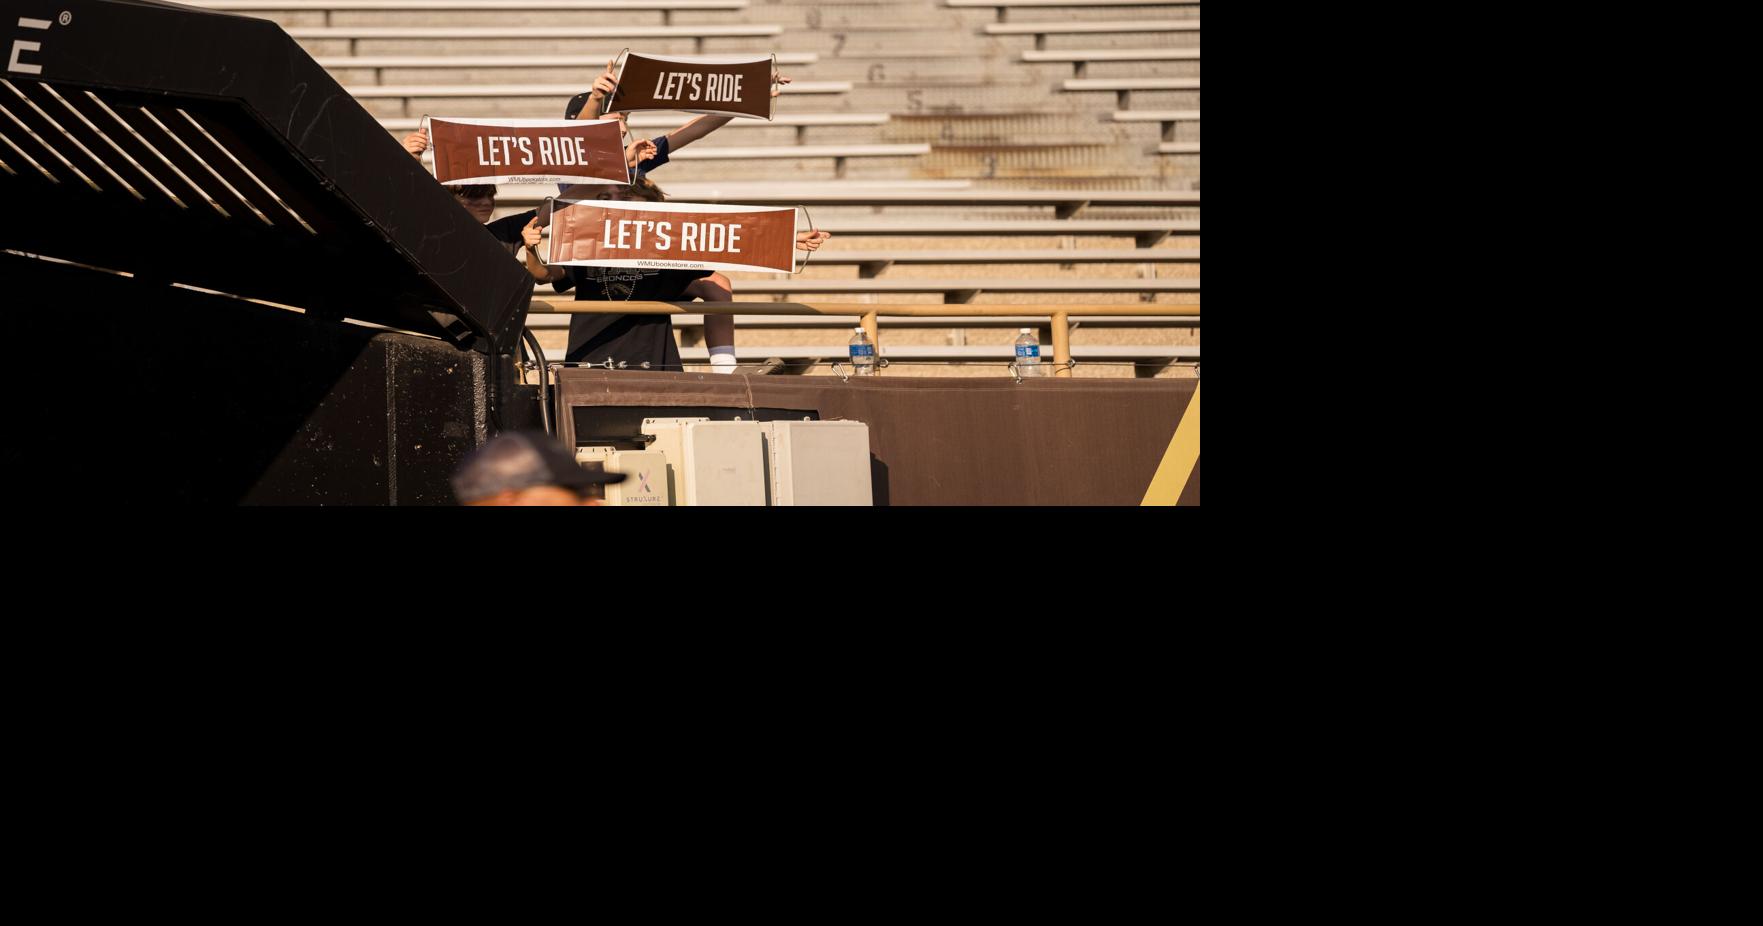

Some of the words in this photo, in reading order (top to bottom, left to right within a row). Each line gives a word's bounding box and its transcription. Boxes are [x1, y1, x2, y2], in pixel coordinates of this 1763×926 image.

[653, 71, 702, 101] LET'S
[705, 73, 743, 102] RIDE
[477, 136, 534, 166] LET'S
[538, 136, 589, 166] RIDE
[603, 219, 672, 251] LET'S
[681, 222, 742, 253] RIDE
[596, 273, 643, 284] BRONCOS
[636, 260, 705, 269] WMUbookstore.com
